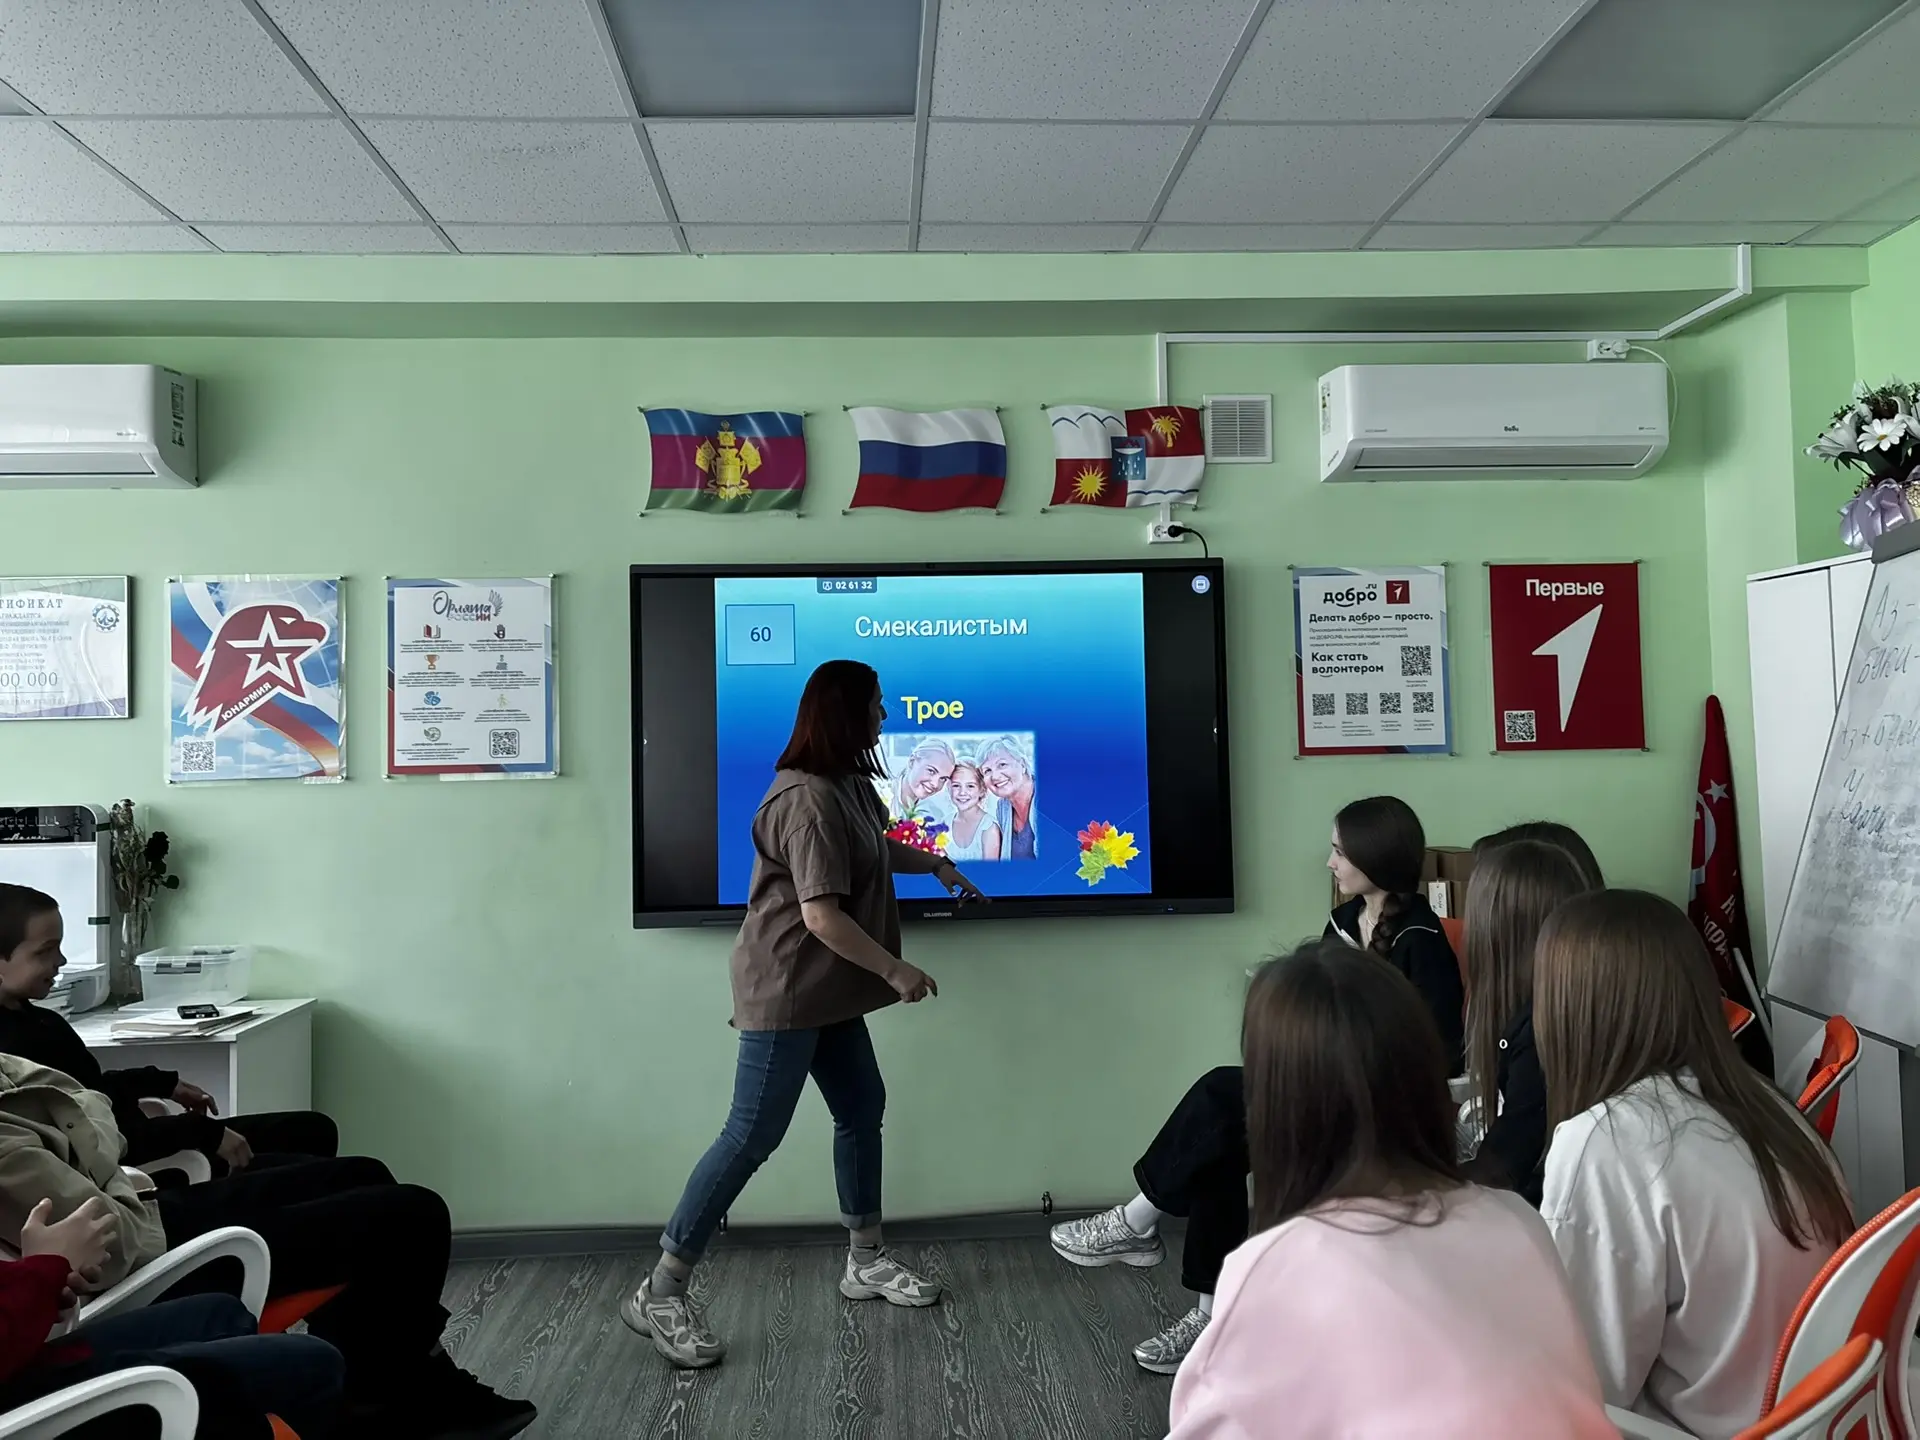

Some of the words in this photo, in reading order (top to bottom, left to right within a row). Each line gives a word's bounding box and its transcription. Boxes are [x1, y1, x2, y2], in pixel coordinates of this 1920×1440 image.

[835, 581, 846, 589] 02
[848, 581, 859, 589] 61
[861, 581, 873, 589] 32
[1525, 578, 1604, 601] Первые
[1323, 587, 1377, 605] добро
[1309, 613, 1346, 623] Делать
[1348, 612, 1381, 623] добро
[1395, 612, 1433, 622] просто.
[751, 626, 771, 642] 60
[855, 616, 1028, 637] Смекалистым
[1311, 652, 1334, 662] Как
[1336, 652, 1369, 662] стать
[1311, 664, 1384, 675] волонтером
[27, 671, 58, 687] 000
[221, 681, 272, 721] ЮНАРМИЯ
[900, 696, 964, 725] Трое
